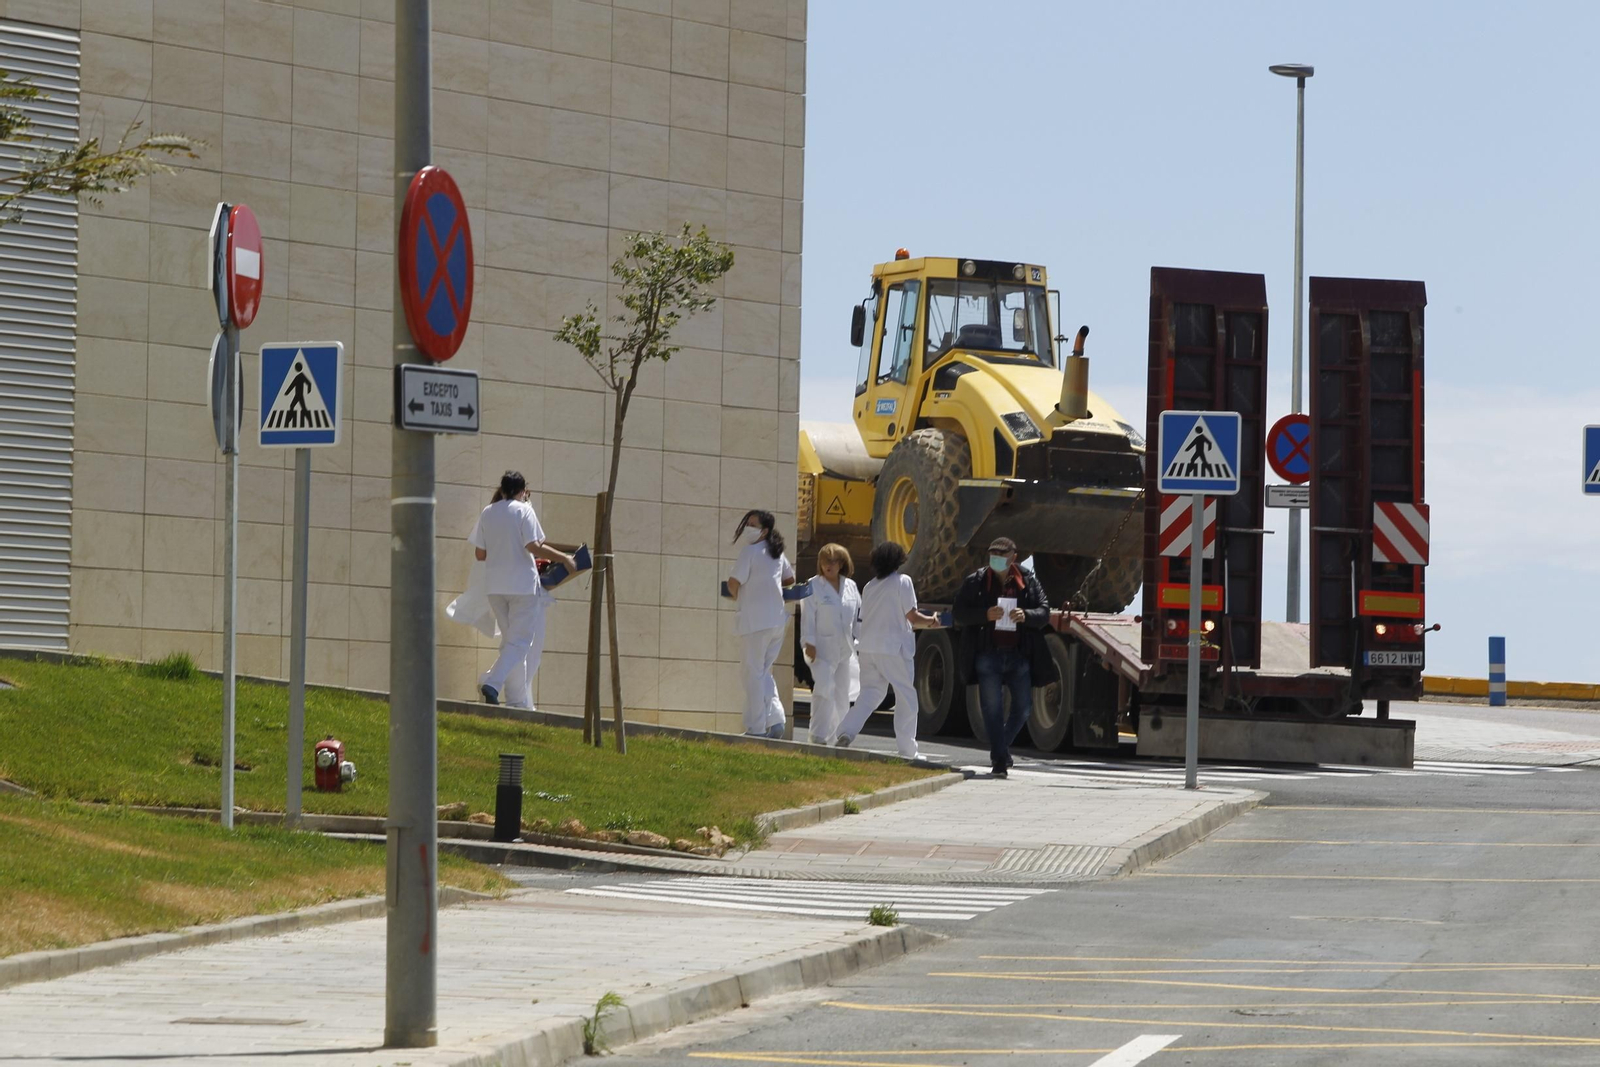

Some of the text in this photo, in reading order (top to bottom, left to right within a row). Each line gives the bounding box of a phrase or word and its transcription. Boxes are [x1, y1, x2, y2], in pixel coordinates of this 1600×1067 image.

[423, 382, 459, 399] EXCEPTO
[430, 401, 453, 417] TAXIS
[1370, 653, 1421, 664] 6612 HWH
